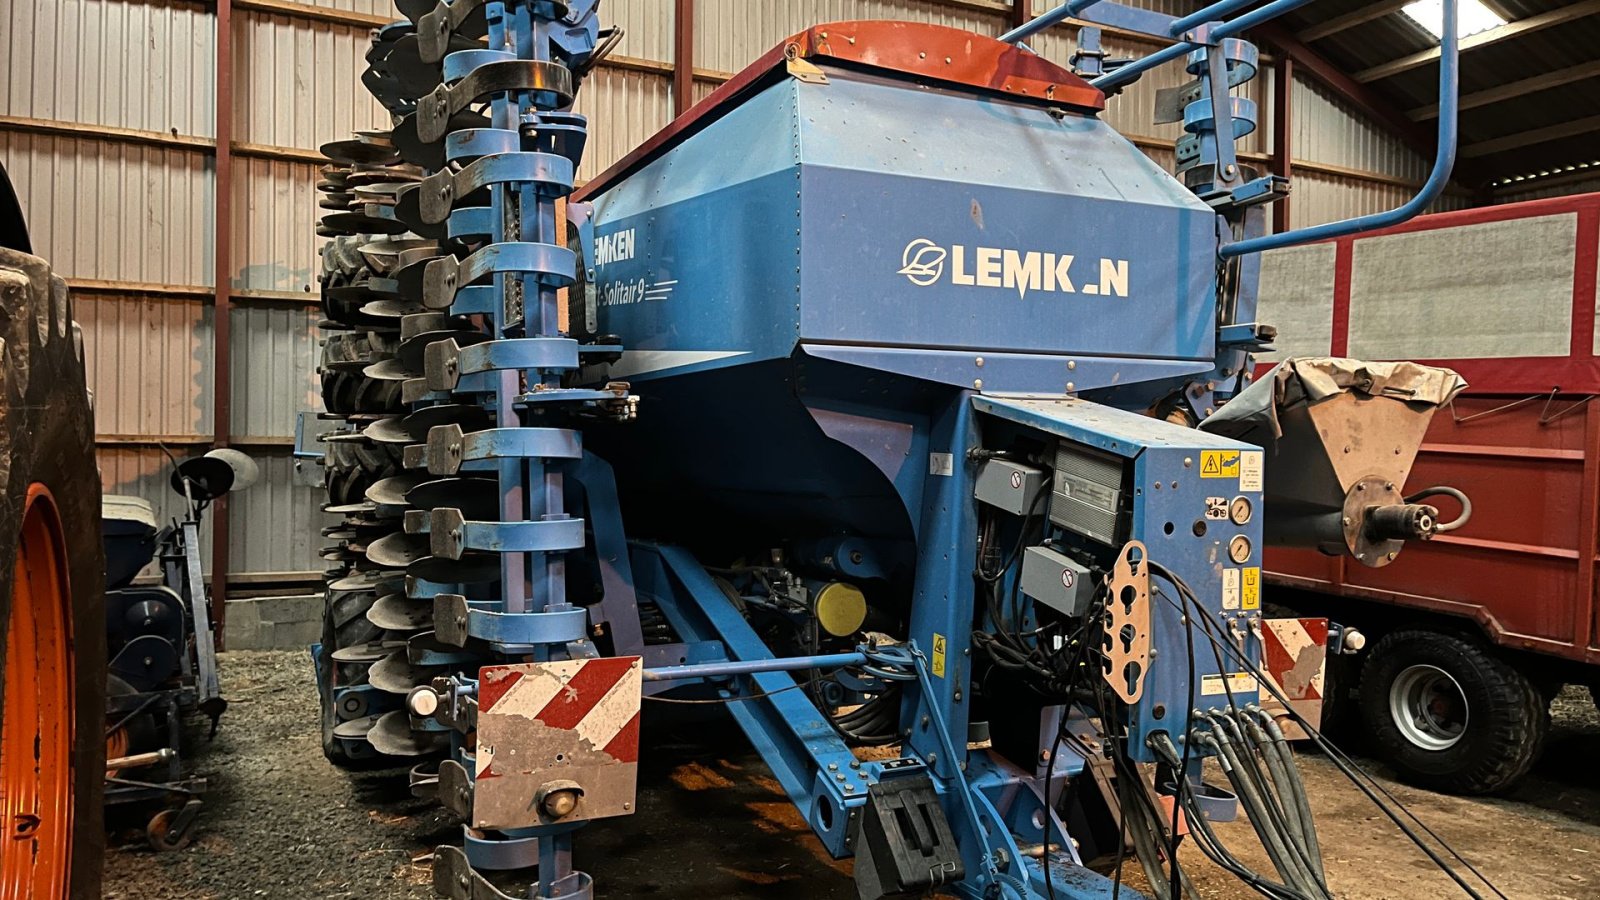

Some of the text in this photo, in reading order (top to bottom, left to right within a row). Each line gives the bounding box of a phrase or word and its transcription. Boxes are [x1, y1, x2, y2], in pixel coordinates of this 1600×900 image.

[594, 228, 635, 272] EMKEN
[597, 278, 645, 307] t-Solitair 9
